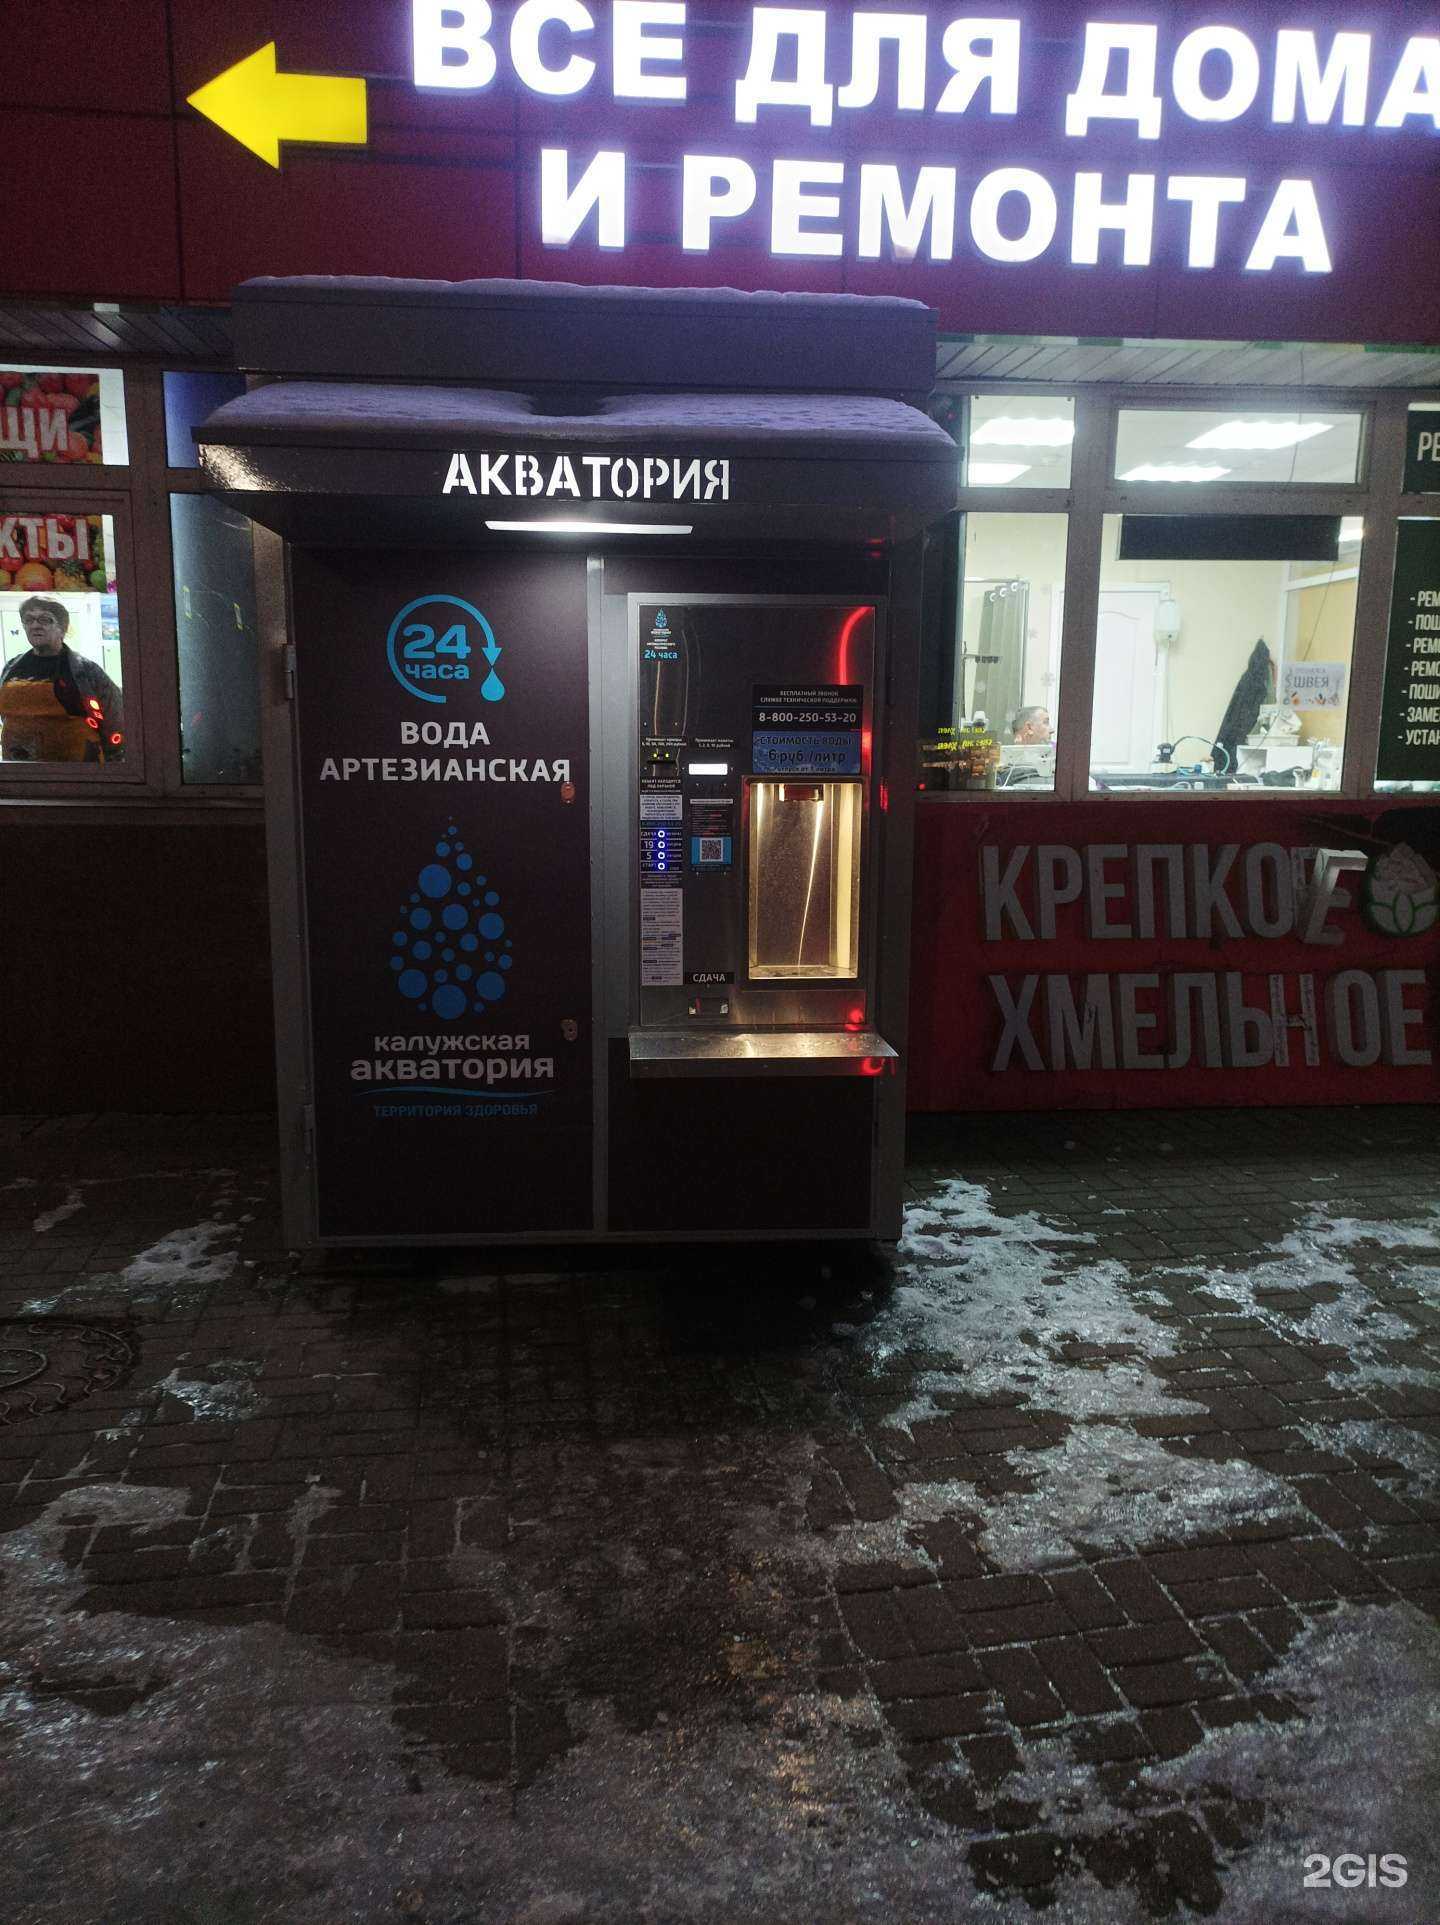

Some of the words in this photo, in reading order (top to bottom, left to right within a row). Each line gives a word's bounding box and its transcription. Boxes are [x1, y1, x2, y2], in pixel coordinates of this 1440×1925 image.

[412, 0, 688, 102] ВСЕ
[734, 9, 1021, 127] ДЛЯ
[1065, 21, 1440, 140] ДОМА
[538, 148, 627, 248] И
[681, 154, 1333, 274] РЕМОНТА
[441, 452, 731, 501] АКВАТОРИЯ
[402, 624, 471, 660] 24
[1413, 637, 1440, 653] РЕМ
[644, 650, 656, 659] 24
[658, 651, 678, 659] часа
[404, 662, 470, 680] часа
[758, 712, 857, 723] 8-800-250-53-20
[400, 721, 491, 748] ВОДА
[760, 735, 819, 745] СТОИМОСТЬ
[319, 757, 572, 783] АРТЕЗИАНСКАЯ
[644, 840, 654, 849] 19
[980, 842, 1369, 945] КРЕПКОЕ
[692, 973, 726, 983] СДАЧА
[988, 969, 1432, 1072] ХМЕЛЬНОЕ
[374, 1034, 531, 1056] калужская
[350, 1057, 555, 1084] акватория
[374, 1104, 463, 1118] ТЕРРИТОРИЯ
[464, 1103, 538, 1118] ЗДОРОВЬЯ
